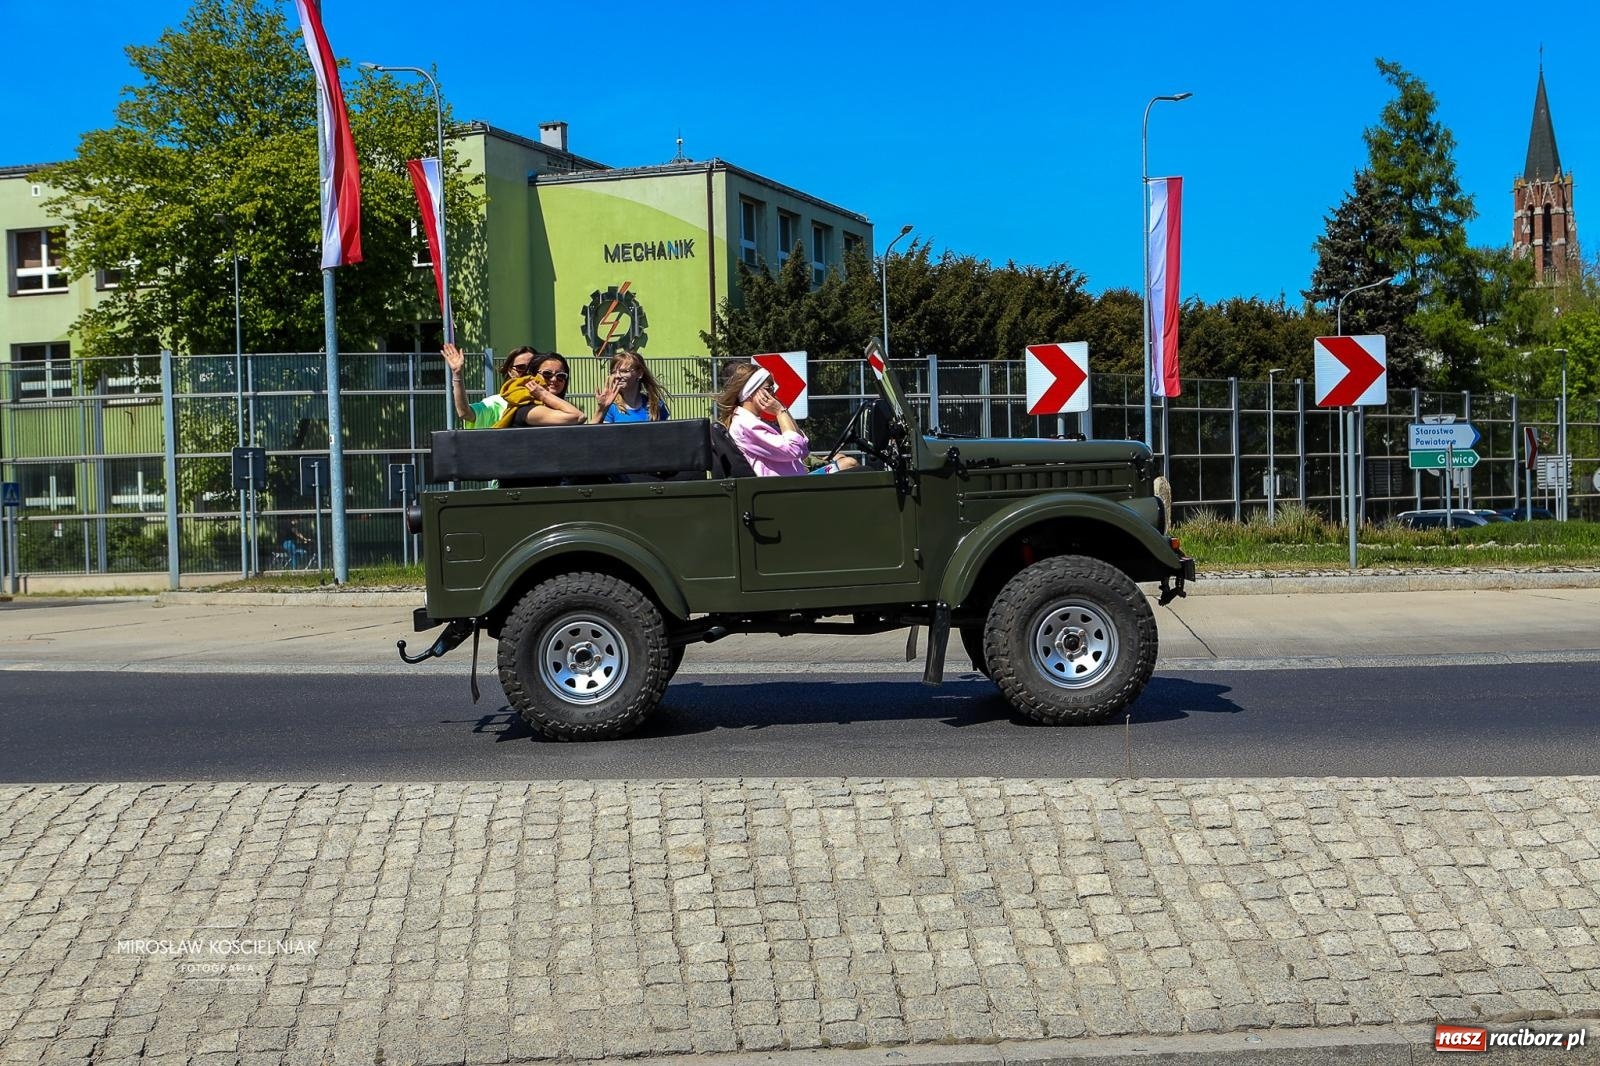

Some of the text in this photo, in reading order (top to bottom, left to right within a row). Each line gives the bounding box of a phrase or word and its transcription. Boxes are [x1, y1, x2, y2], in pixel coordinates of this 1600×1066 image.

[604, 239, 695, 263] MECHANIK
[1415, 427, 1454, 435] Starostwo
[1437, 454, 1474, 464] Gwice
